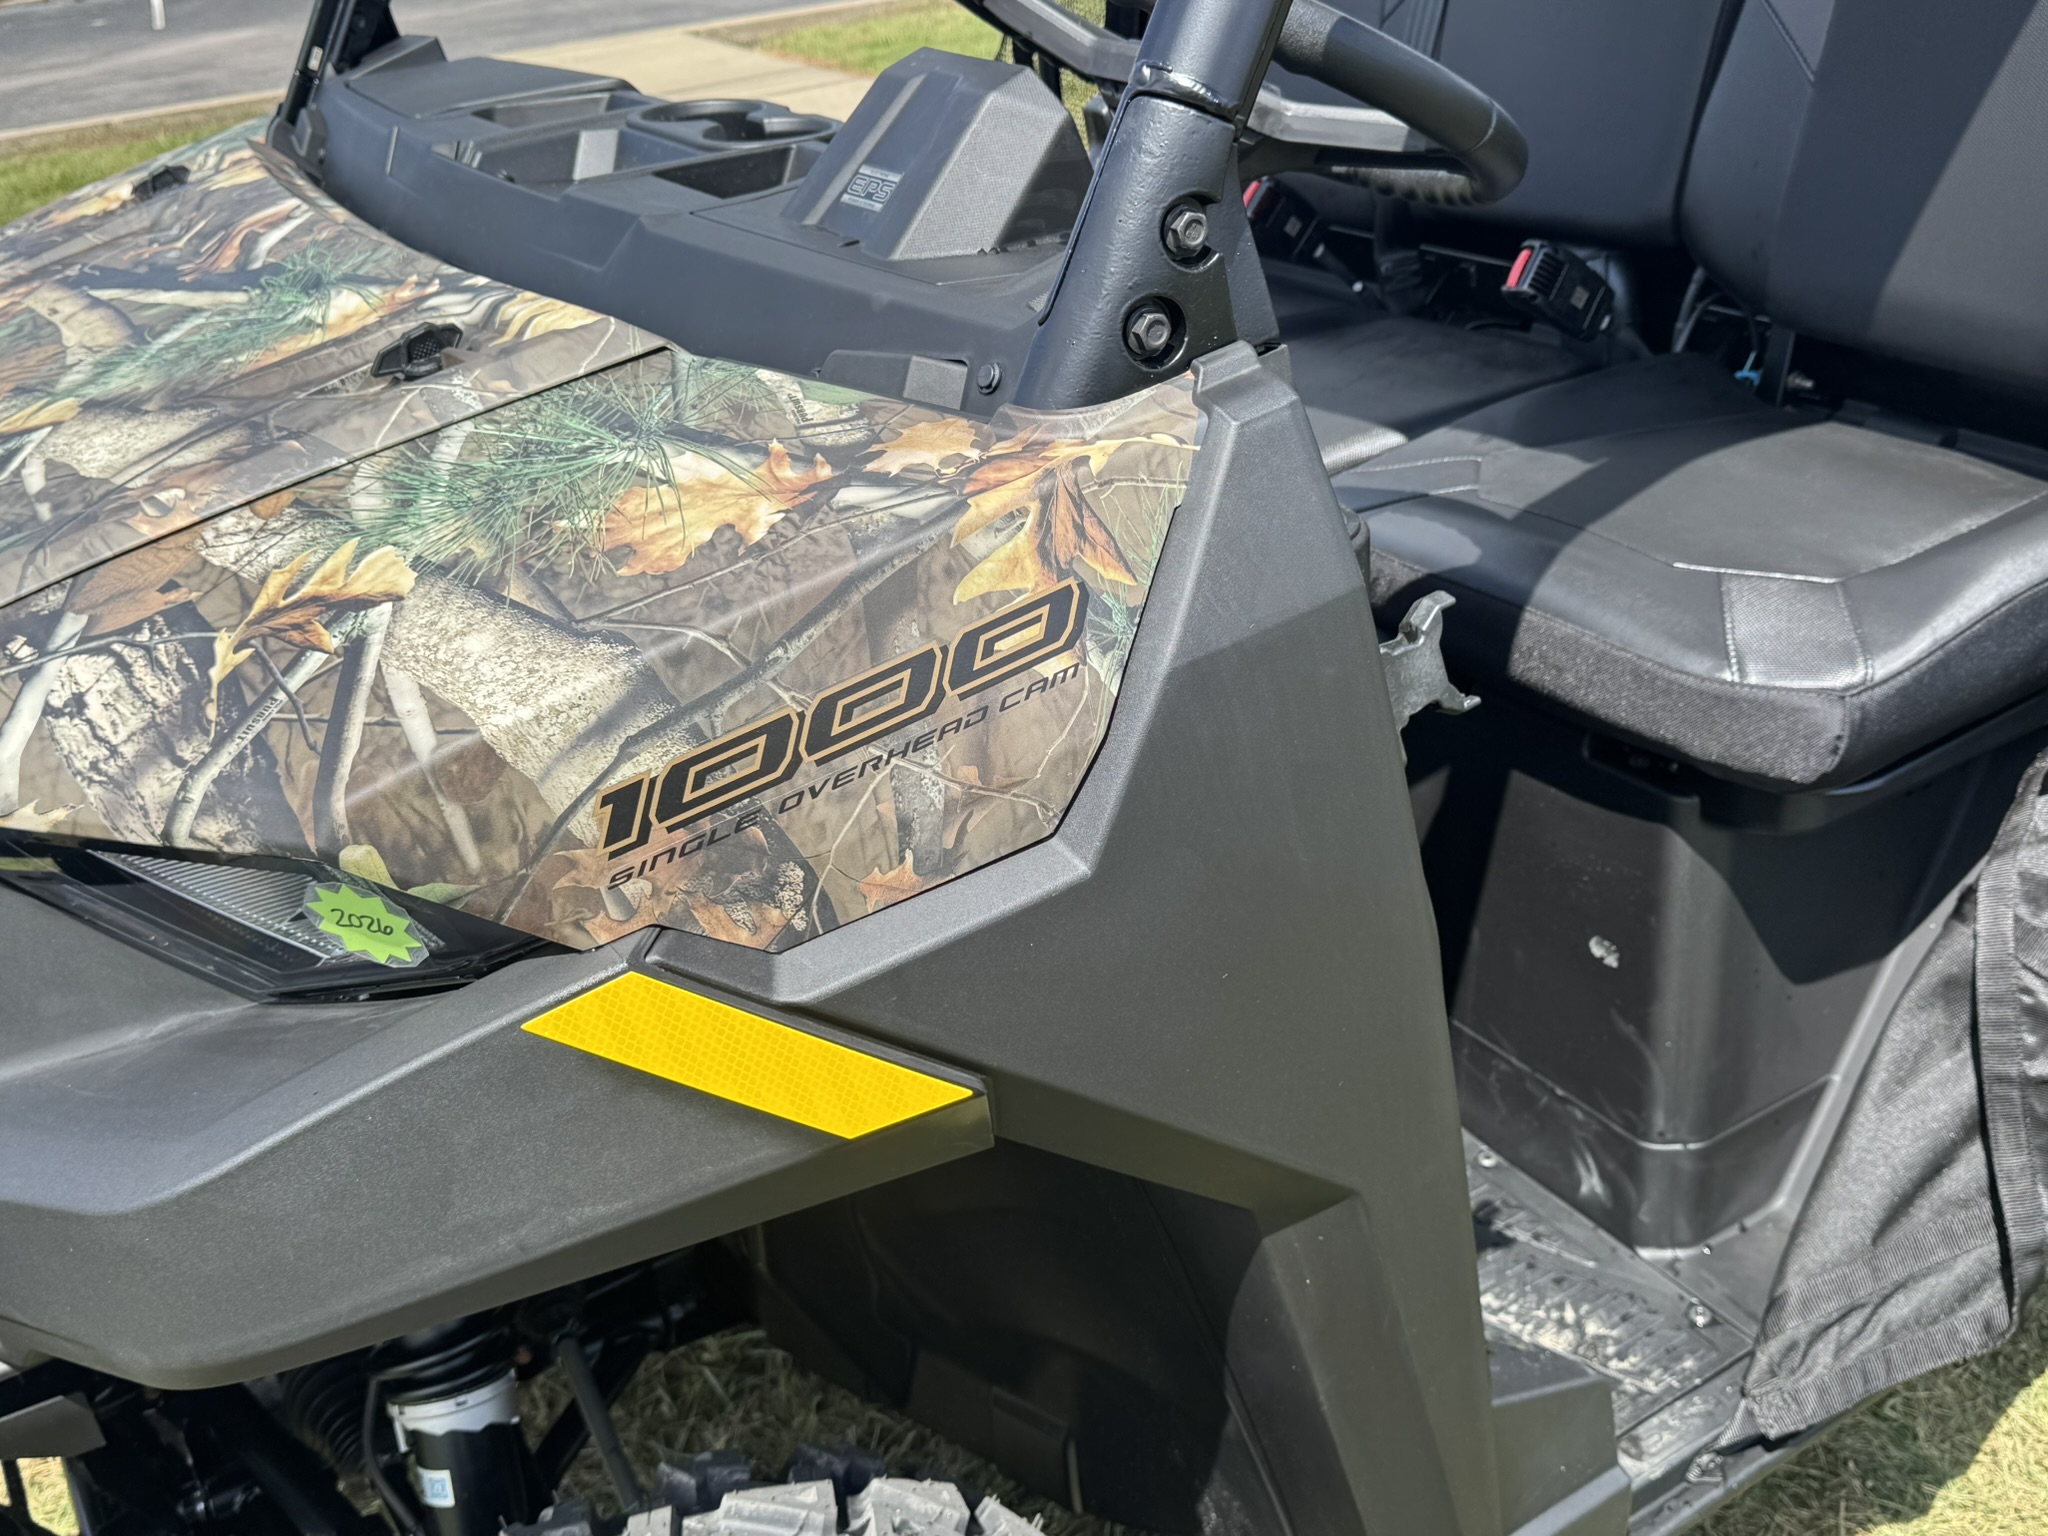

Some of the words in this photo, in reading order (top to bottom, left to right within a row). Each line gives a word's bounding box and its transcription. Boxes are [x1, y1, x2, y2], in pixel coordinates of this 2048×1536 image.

[847, 174, 896, 202] EPS
[237, 695, 279, 743] PURSUIT
[595, 577, 1088, 860] 1000
[608, 813, 761, 890] SINGLE
[778, 705, 989, 815] OVERHEAD
[1000, 662, 1080, 713] CAM
[330, 908, 394, 936] 2026
